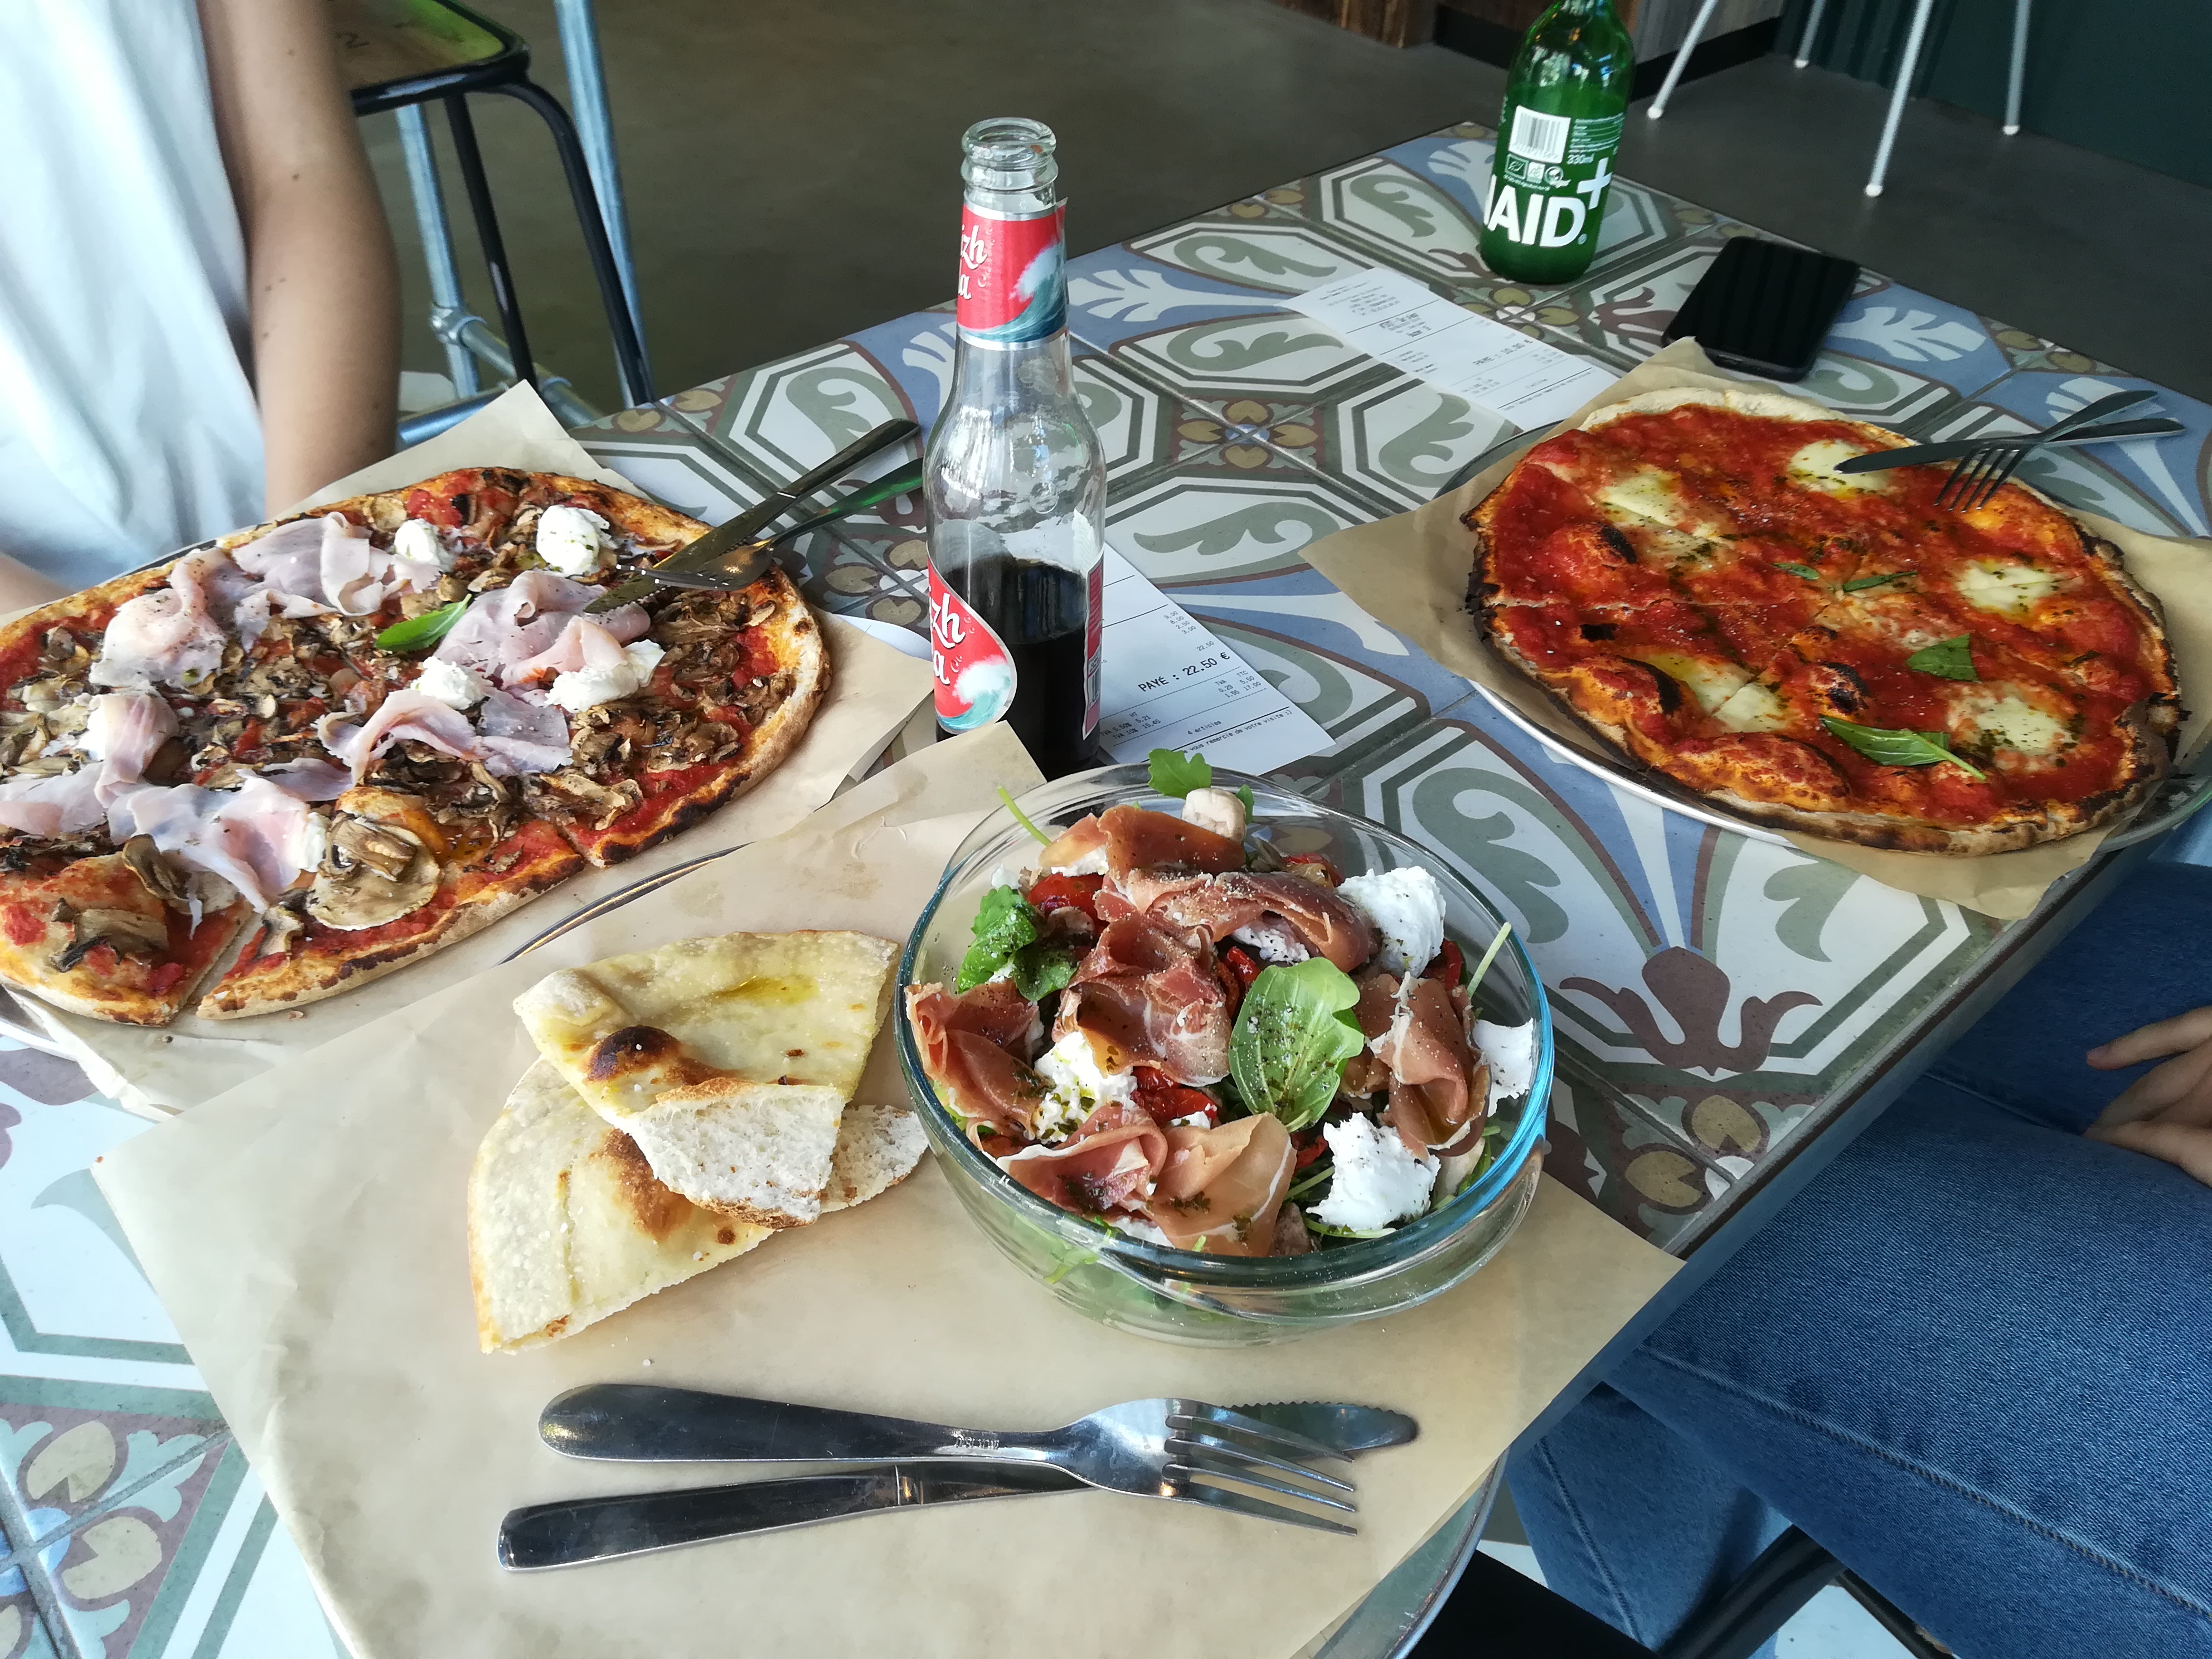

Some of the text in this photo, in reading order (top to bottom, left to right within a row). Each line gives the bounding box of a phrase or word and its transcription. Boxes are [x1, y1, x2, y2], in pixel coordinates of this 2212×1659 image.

[1181, 625, 1196, 634] 3.00
[1196, 641, 1214, 651] 22.50
[1138, 676, 1169, 692] PAYÉ
[1182, 658, 1217, 676] 22.50
[1220, 652, 1230, 660] €
[1112, 722, 1133, 732] 5.50%
[1135, 715, 1151, 723] 5.21
[1239, 676, 1255, 684] 5.50
[1142, 719, 1161, 729] 15.45
[1243, 681, 1261, 691] 17.00
[1189, 743, 1205, 751] vous
[1206, 731, 1234, 745] remercie
[1244, 721, 1262, 730] votre
[1263, 712, 1284, 724] visite
[1194, 720, 1222, 733] articles
